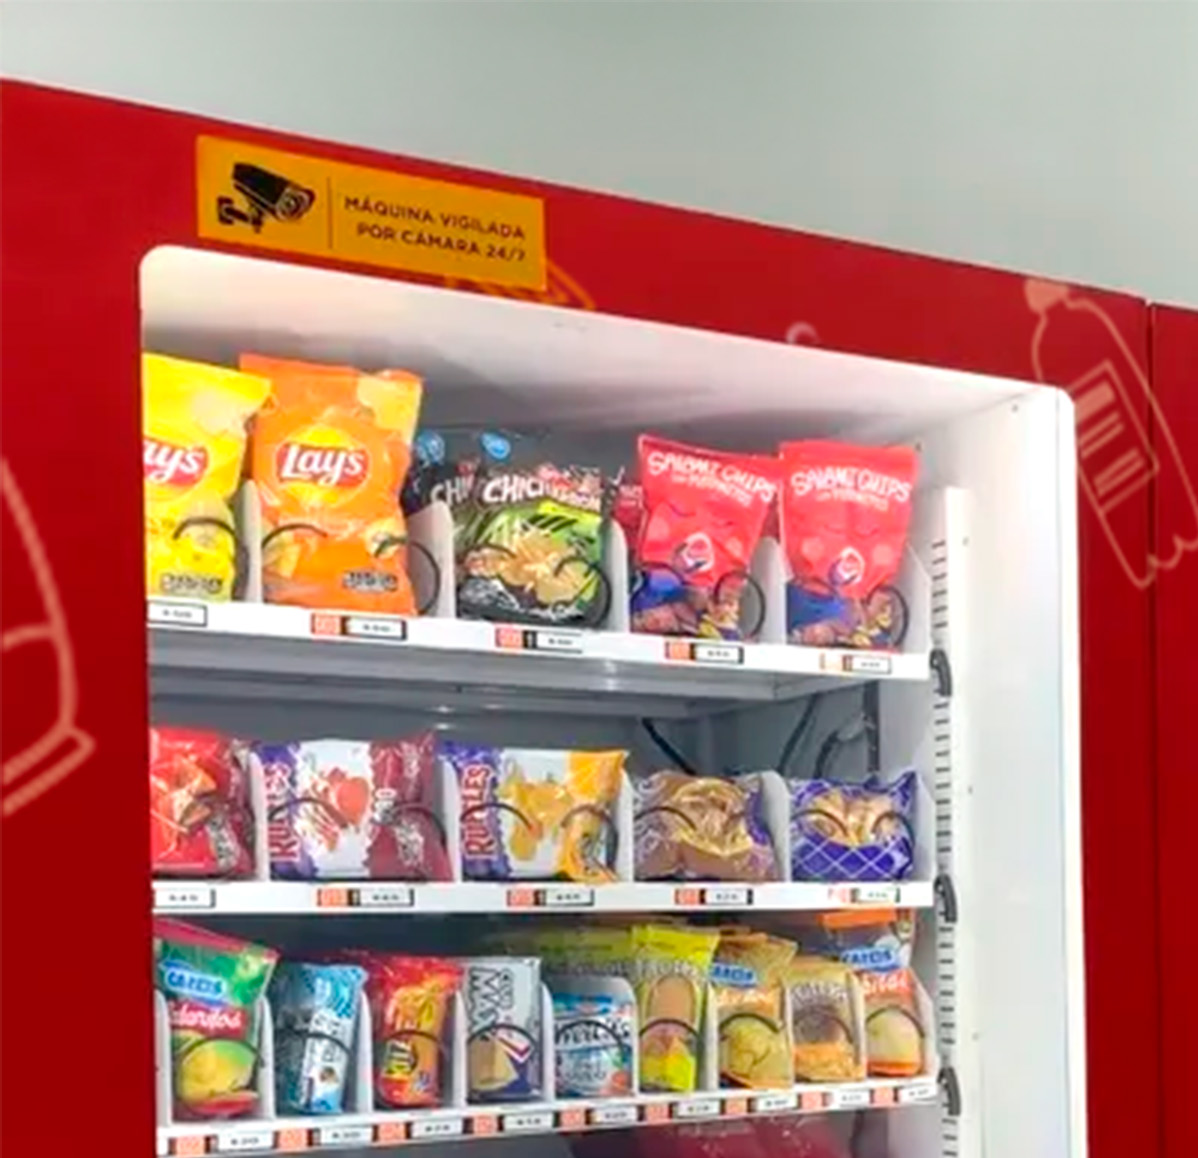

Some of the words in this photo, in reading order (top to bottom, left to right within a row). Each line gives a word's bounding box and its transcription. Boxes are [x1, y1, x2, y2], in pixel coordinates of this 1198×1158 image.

[344, 196, 434, 224] MÁQUINA
[440, 212, 525, 240] VIGILADA
[356, 221, 396, 241] POR
[400, 228, 482, 256] CÁMARA
[486, 243, 526, 262] 24/7
[721, 465, 778, 502] CHIPS
[856, 469, 912, 502] CHIPS
